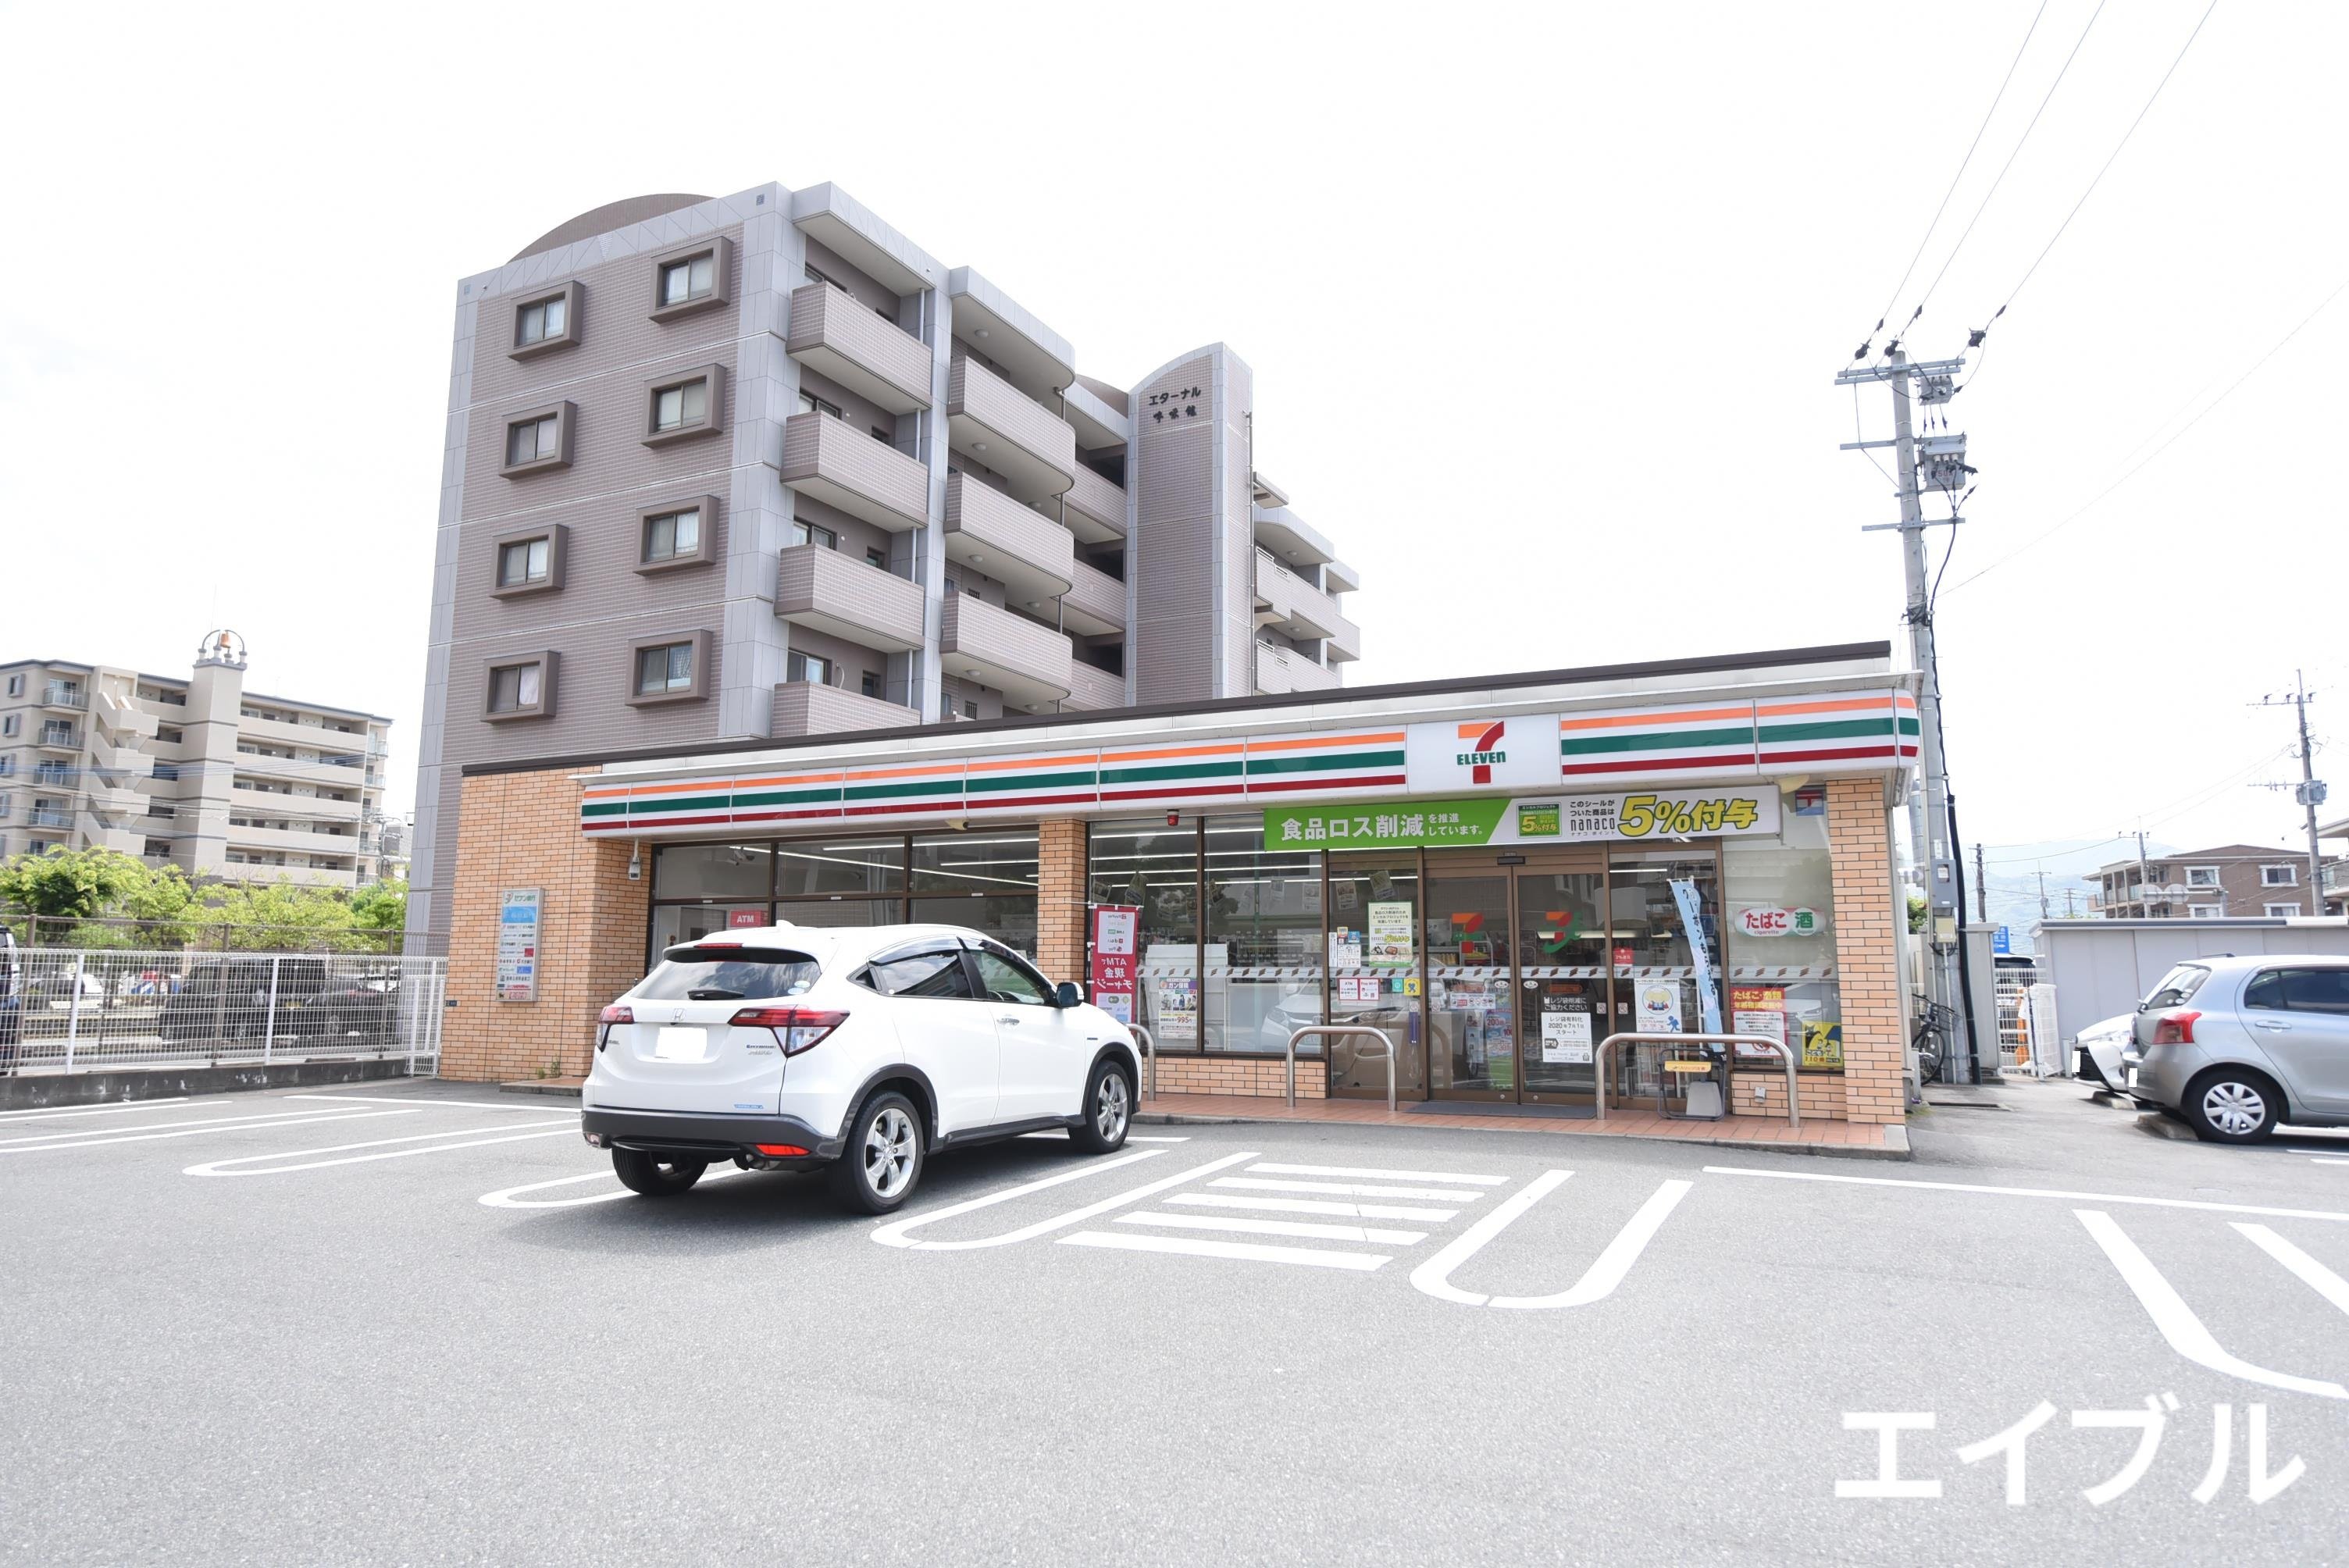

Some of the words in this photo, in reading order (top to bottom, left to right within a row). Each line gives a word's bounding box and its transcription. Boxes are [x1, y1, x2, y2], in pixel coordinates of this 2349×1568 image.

[1149, 387, 1201, 405] エターナル
[1570, 800, 1616, 808] このシールが
[1428, 813, 1460, 824] を推進
[1570, 808, 1615, 817] ついた商品は
[1617, 795, 1759, 837] 5%付与
[1281, 814, 1424, 841] 食品ロス削減
[1428, 825, 1483, 836] しています。
[1570, 818, 1615, 832] nanaco
[736, 914, 754, 923] ATM
[1745, 912, 1787, 929] たばこ
[1795, 911, 1813, 928] 酒
